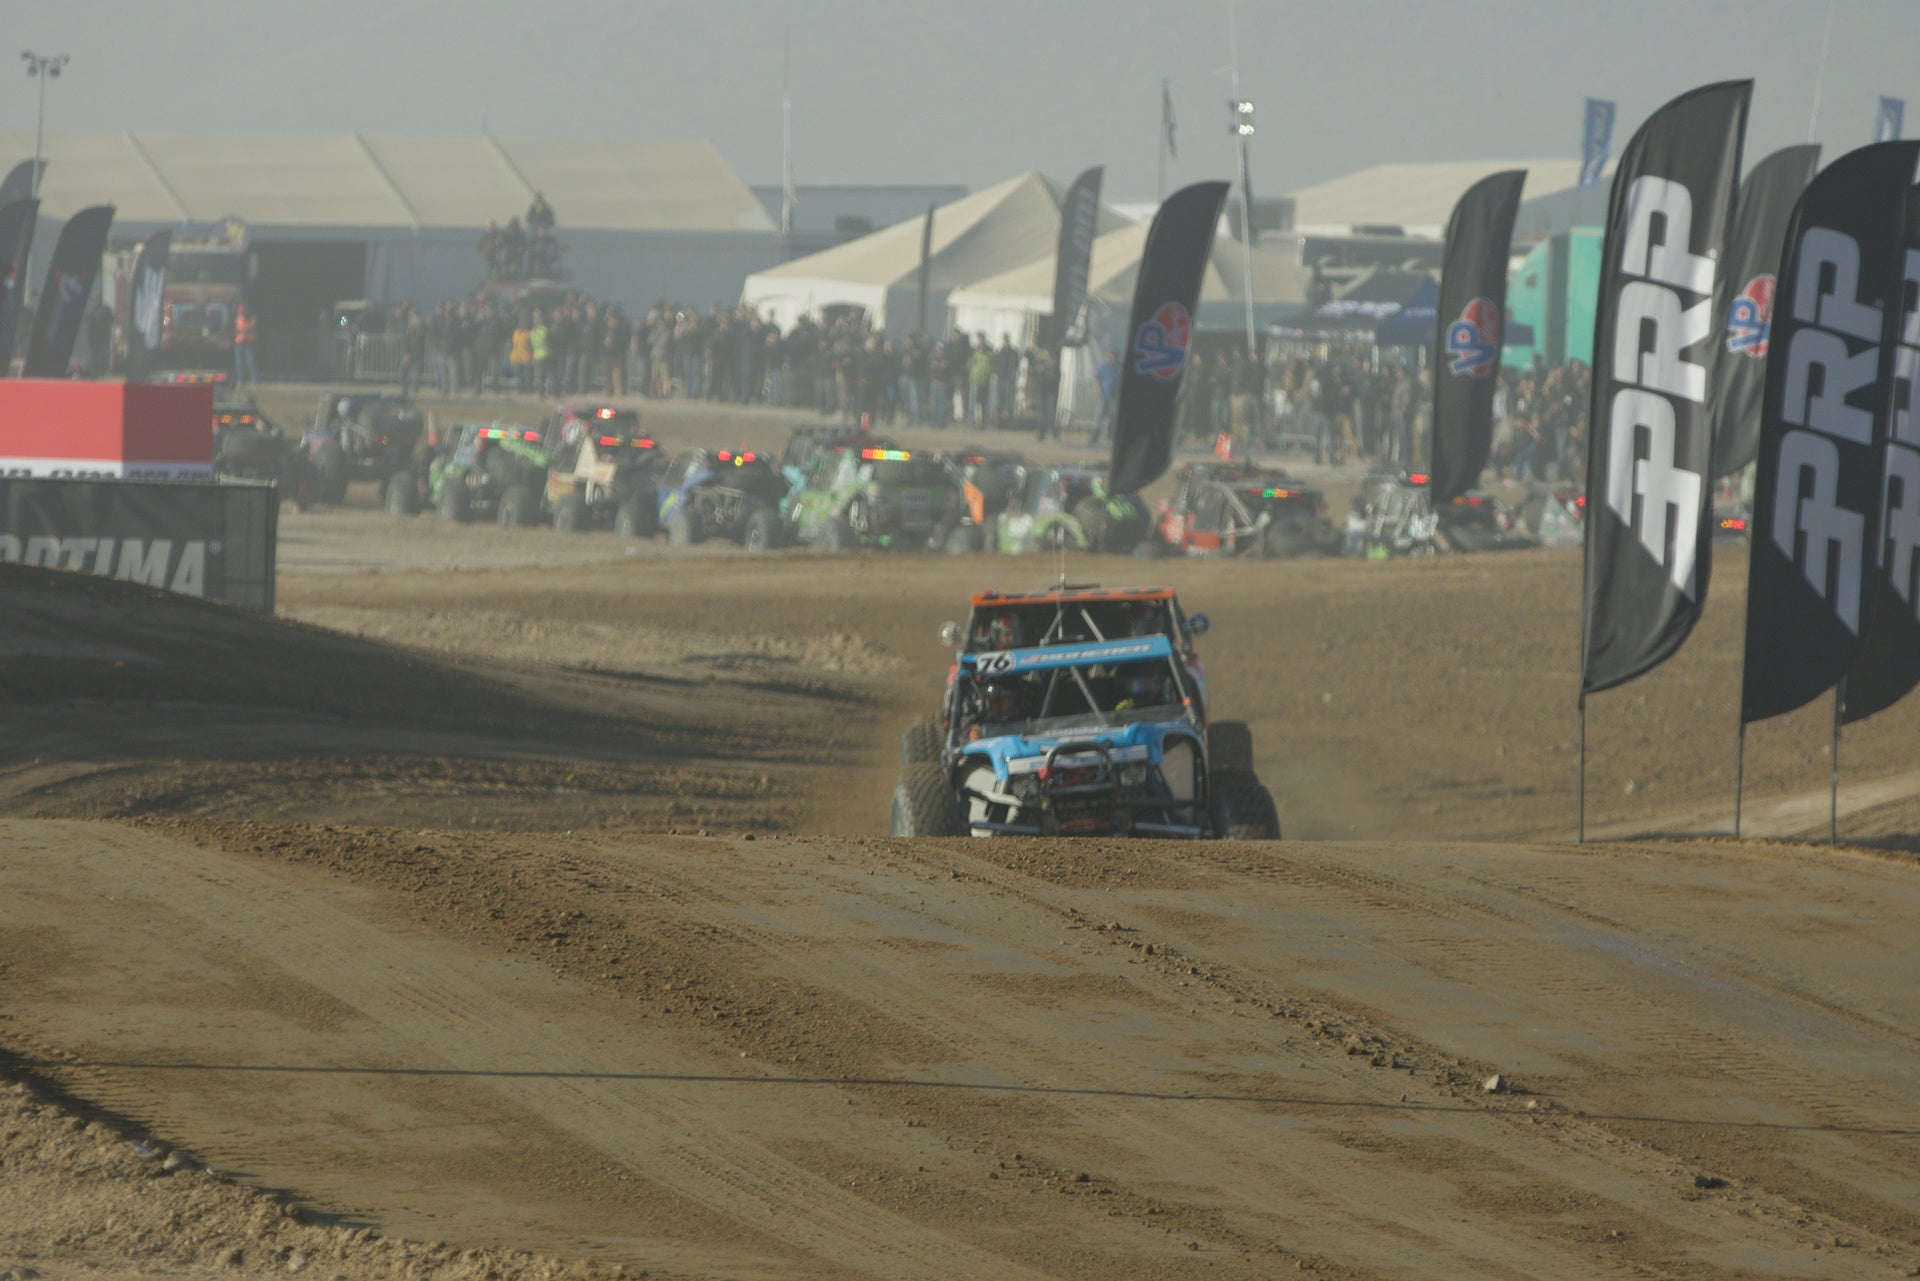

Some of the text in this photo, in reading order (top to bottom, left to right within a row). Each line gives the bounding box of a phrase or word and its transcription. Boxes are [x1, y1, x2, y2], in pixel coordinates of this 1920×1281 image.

[1133, 320, 1187, 375] VP
[1445, 319, 1499, 377] VP
[1726, 295, 1771, 353] VP
[1608, 174, 1716, 602] PRP
[1772, 226, 1885, 639] PRP
[0, 534, 206, 598] PTIMA
[979, 651, 1011, 673] 76
